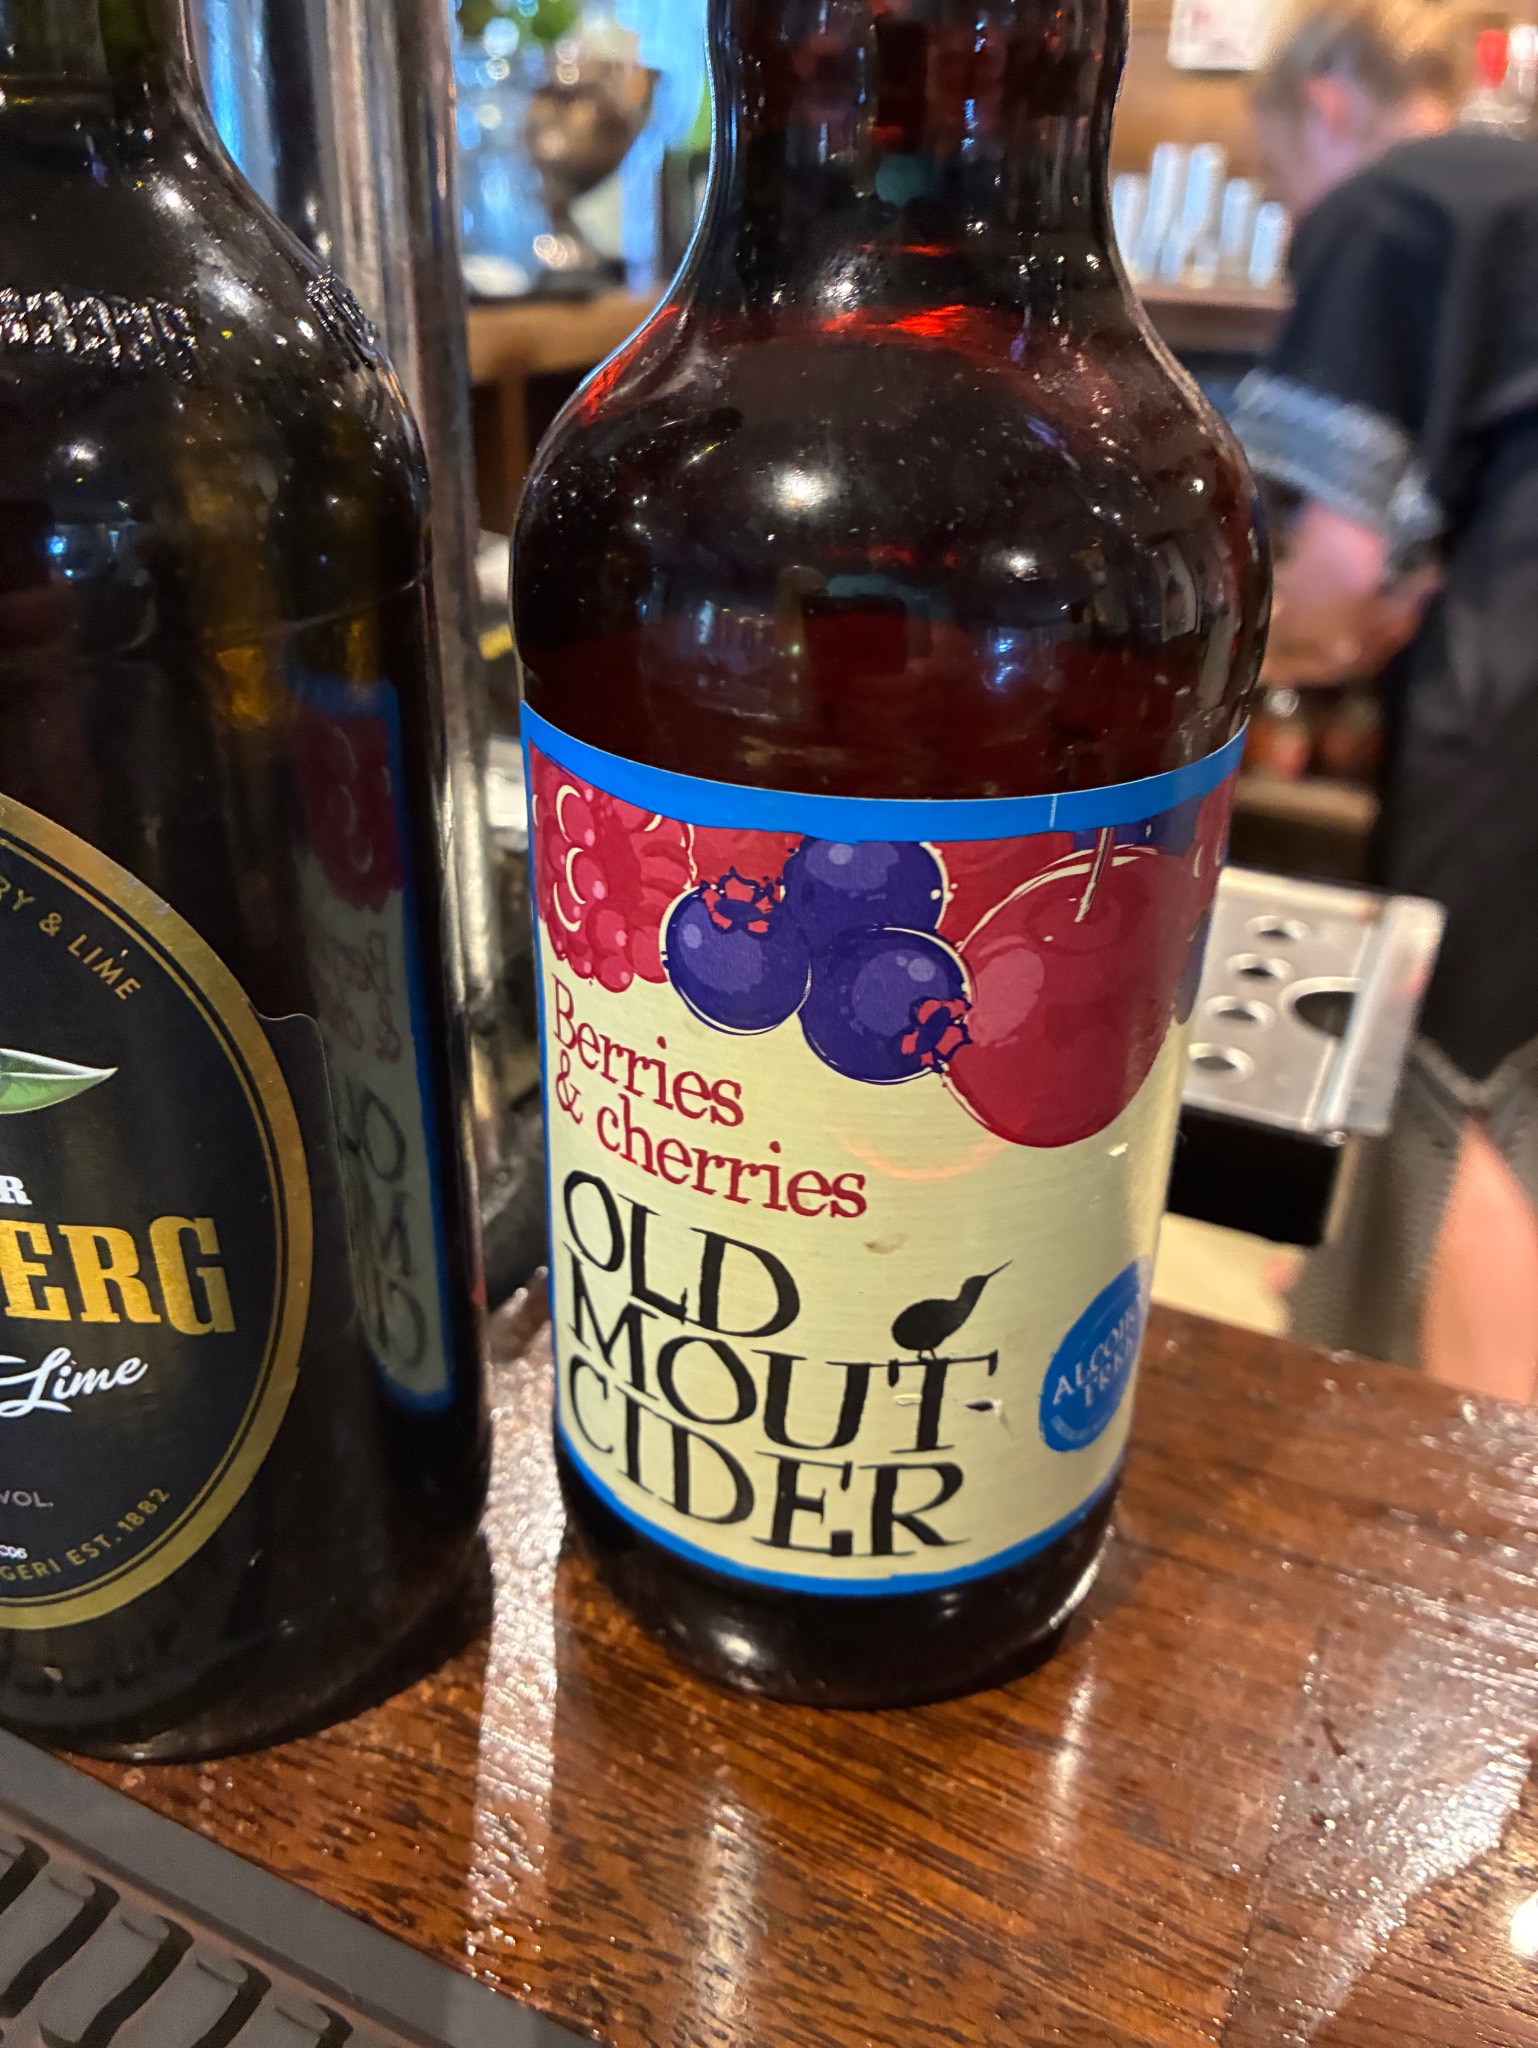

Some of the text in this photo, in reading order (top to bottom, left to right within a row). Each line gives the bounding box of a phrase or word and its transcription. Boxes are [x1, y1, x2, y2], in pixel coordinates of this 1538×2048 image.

[39, 912, 62, 937] &
[67, 934, 142, 1000] LIME
[552, 973, 744, 1127] Berries
[555, 1049, 867, 1218] & cherries
[563, 1169, 800, 1338] OLD
[0, 1346, 148, 1418] Lime
[563, 1241, 999, 1453] MOUT
[569, 1354, 973, 1557] CIDER
